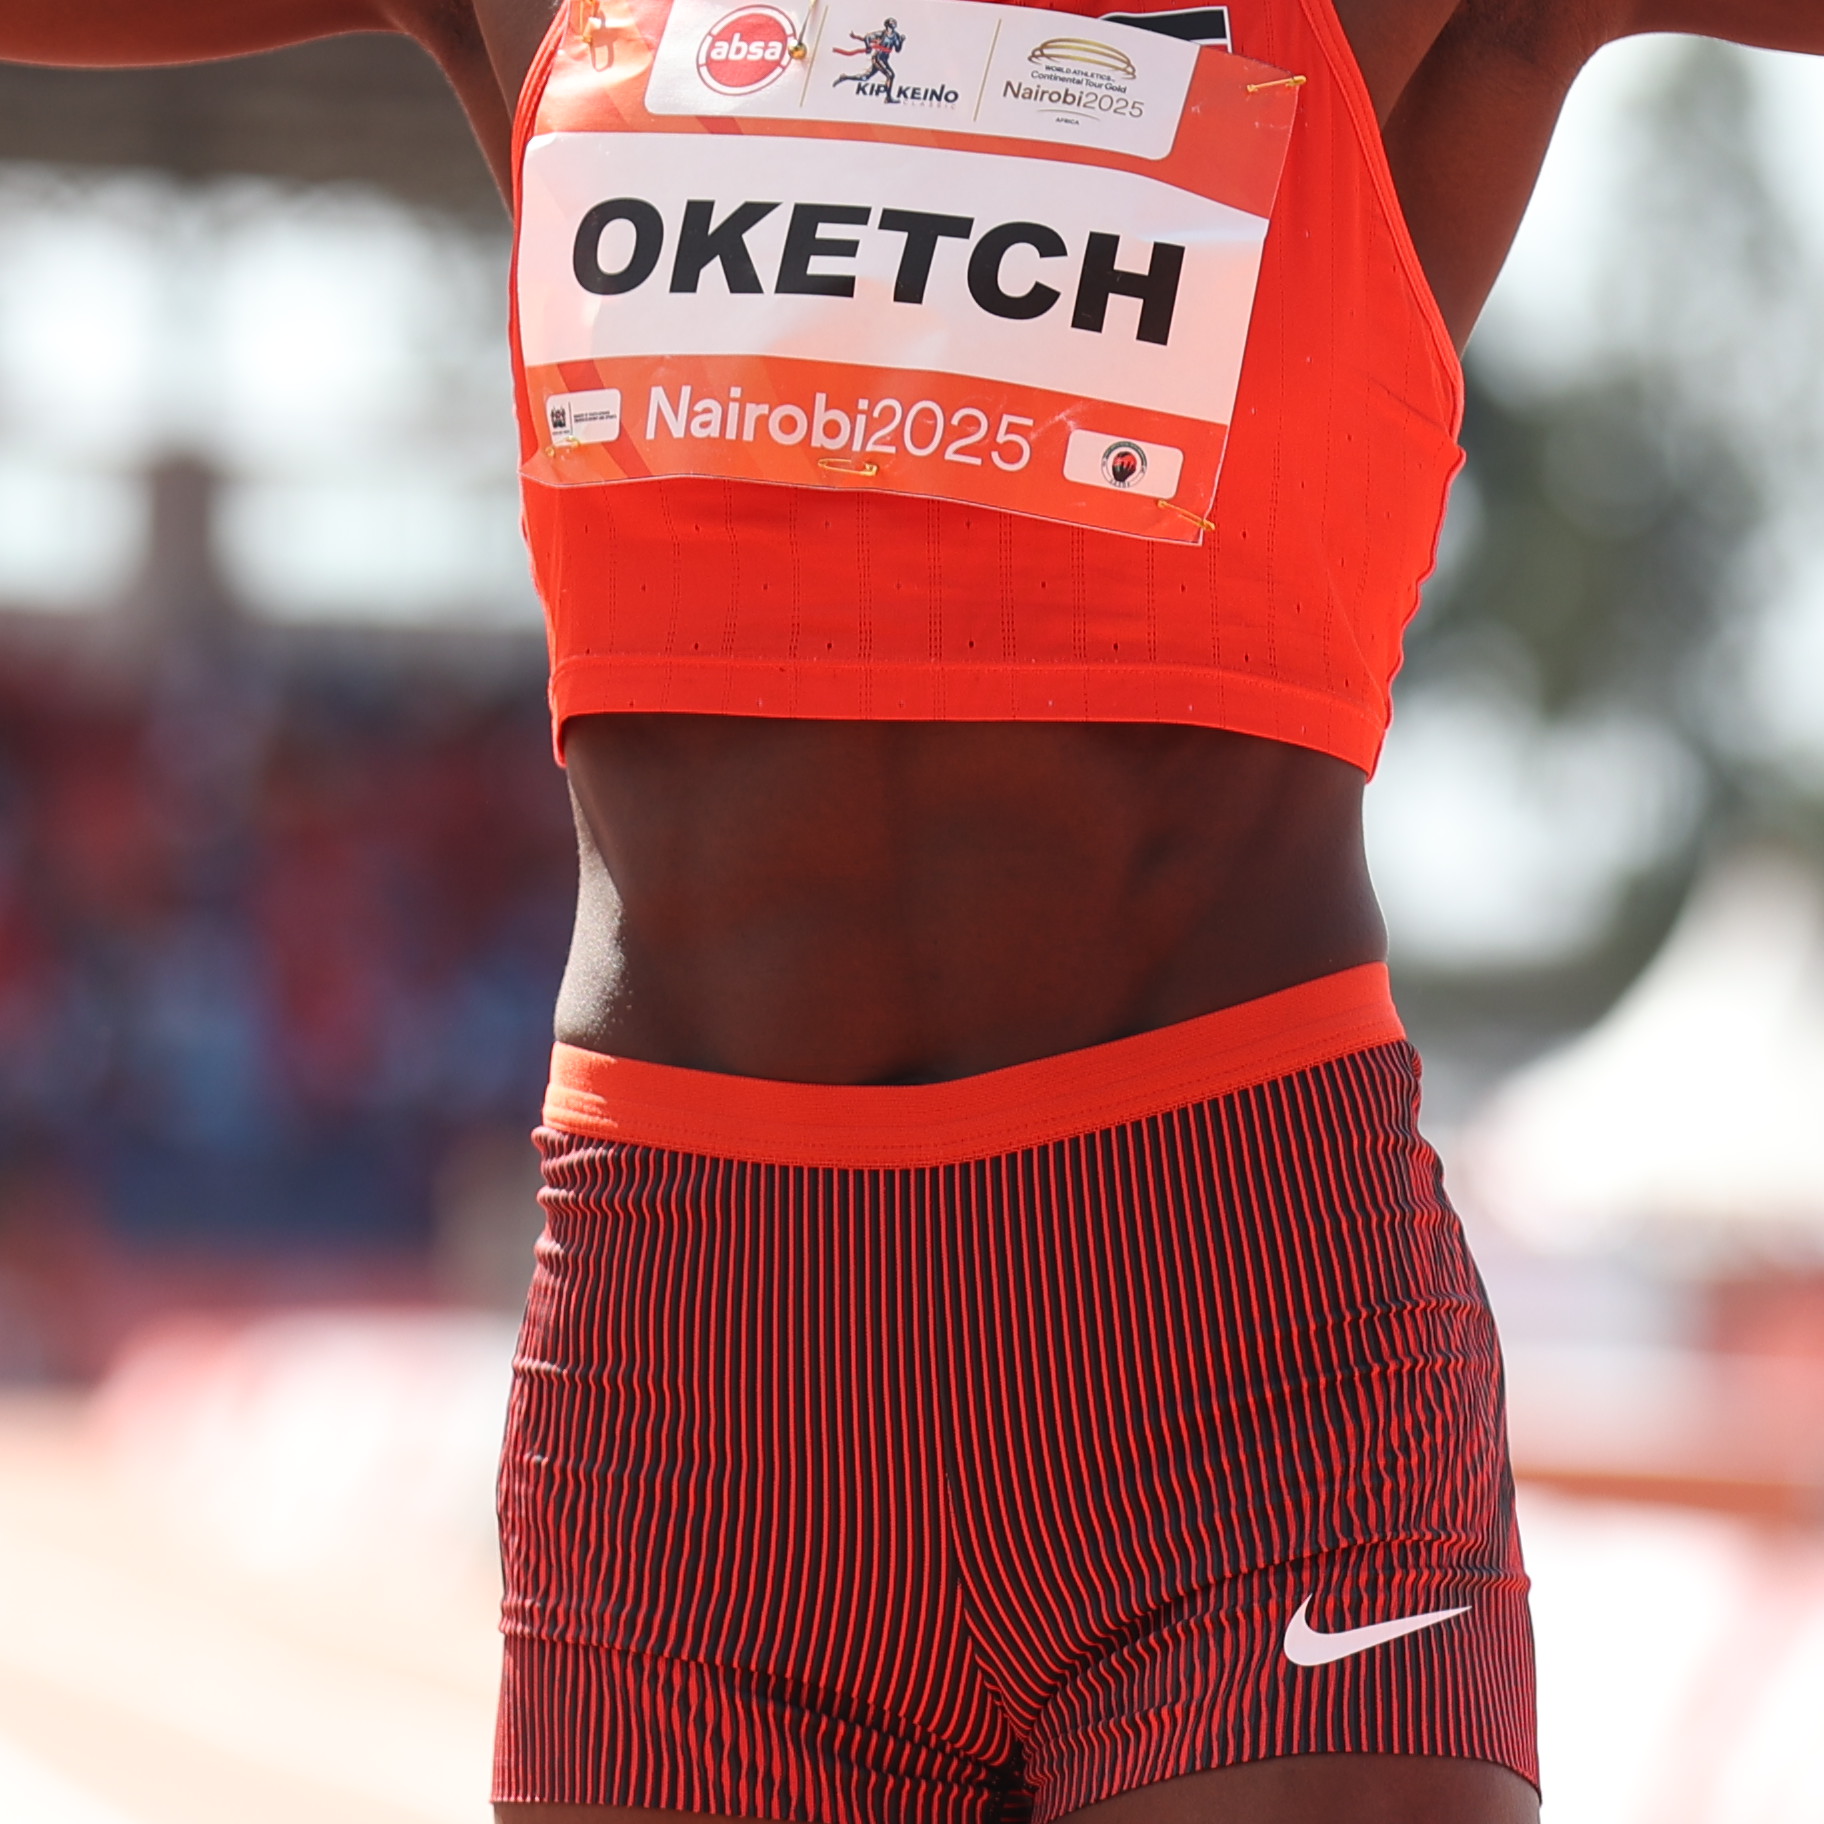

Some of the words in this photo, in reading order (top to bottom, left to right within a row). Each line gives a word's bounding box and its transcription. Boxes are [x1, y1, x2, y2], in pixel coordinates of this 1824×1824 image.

[710, 32, 783, 61] absa
[1031, 70, 1084, 86] Continental
[1085, 80, 1103, 90] Tour
[1104, 82, 1127, 94] Gold
[1044, 64, 1071, 75] WORLD
[856, 82, 888, 97] KIP
[897, 84, 959, 104] KEINO
[1002, 80, 1145, 118] Nairobi2025
[1055, 117, 1080, 125] AFRICA
[572, 197, 1186, 347] OKETCH
[644, 384, 1035, 472] Nairobi2025
